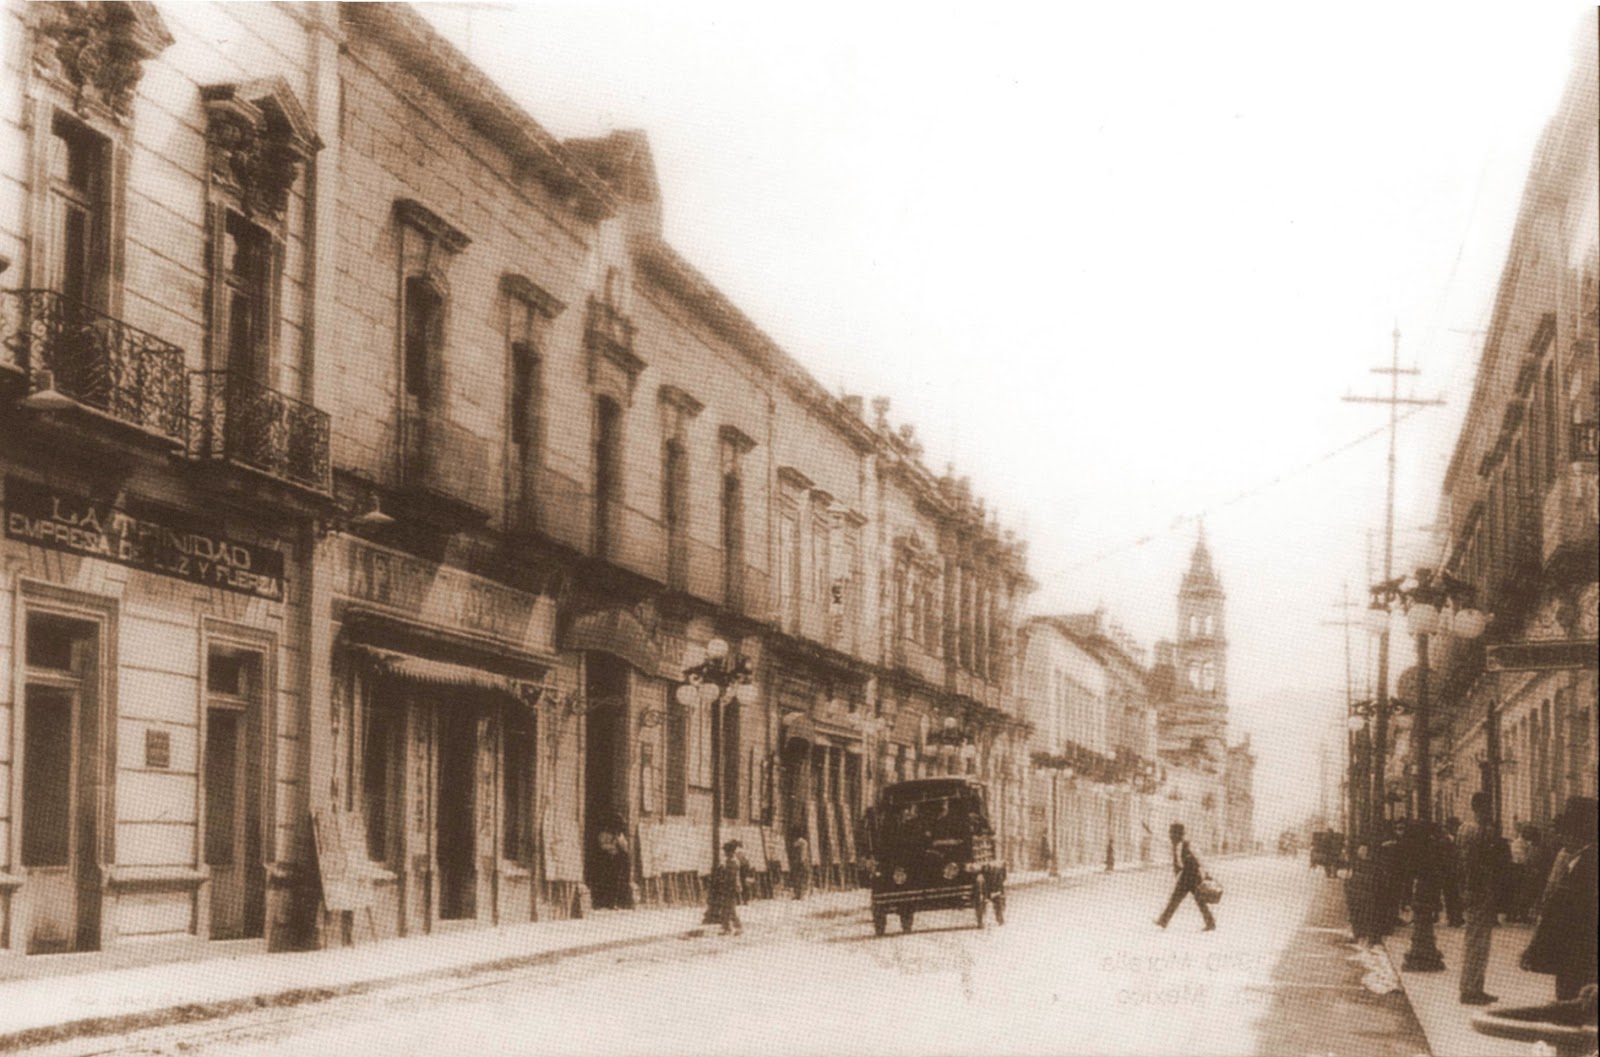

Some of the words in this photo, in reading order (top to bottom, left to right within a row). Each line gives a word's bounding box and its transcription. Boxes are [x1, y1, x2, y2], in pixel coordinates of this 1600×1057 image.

[9, 513, 111, 556] EMPRESA
[118, 538, 145, 563] DE
[198, 561, 209, 579] Y
[215, 564, 281, 597] FUERZA
[52, 497, 104, 533] LA
[112, 513, 251, 570] TRINIDAD
